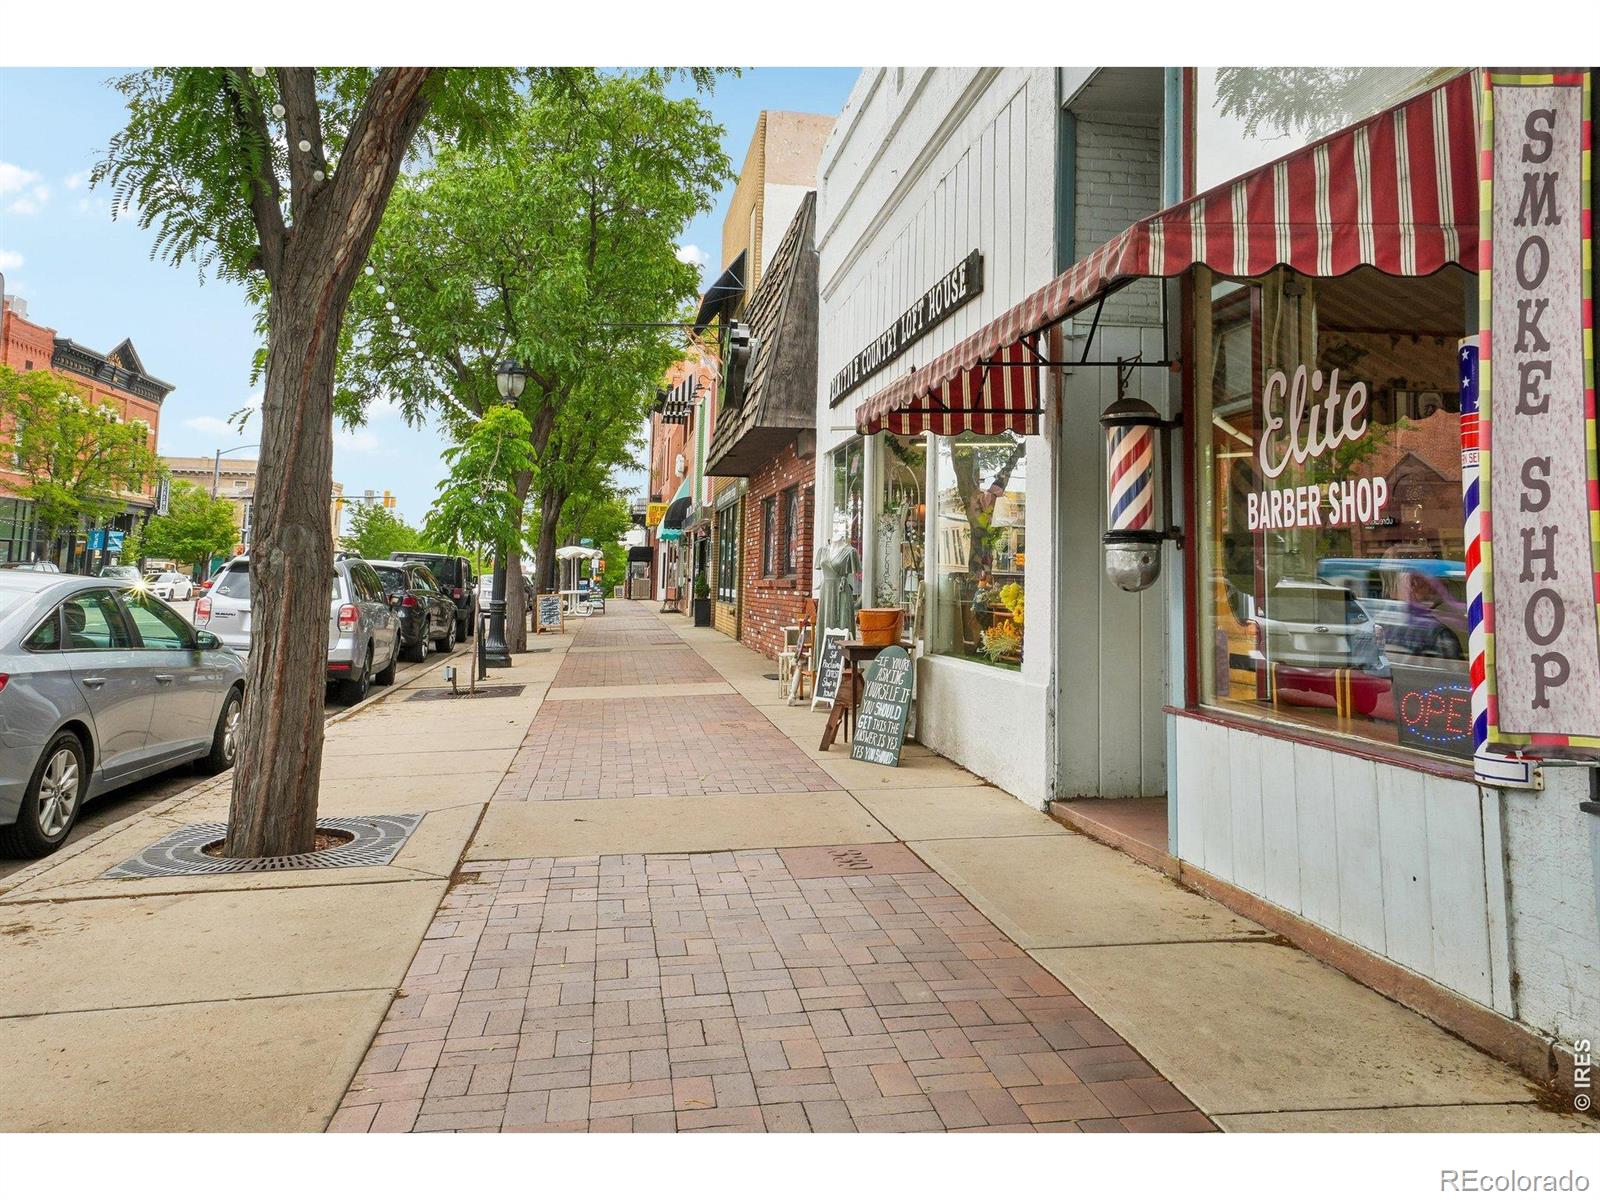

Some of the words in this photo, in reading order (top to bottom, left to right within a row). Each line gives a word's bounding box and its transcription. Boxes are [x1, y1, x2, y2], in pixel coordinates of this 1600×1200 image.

[1513, 109, 1562, 415] SMOKE
[861, 322, 898, 375] COUNTRY
[901, 299, 924, 345] LOFT
[928, 261, 967, 322] HOUSE
[1259, 364, 1368, 479] Elite
[1247, 483, 1322, 531] BARBER
[1328, 476, 1389, 526] SHOP
[1519, 456, 1571, 710] SHOP
[865, 680, 900, 701] YOURSELF
[899, 687, 911, 703] IF
[875, 667, 905, 685] ASKING
[858, 714, 873, 729] GET
[887, 721, 900, 734] THE
[862, 699, 875, 714] YOU
[874, 701, 902, 720] SHOULD
[1402, 692, 1473, 735] OPE
[852, 744, 864, 759] YES
[853, 729, 878, 746] ANSWER
[877, 734, 886, 748] IS
